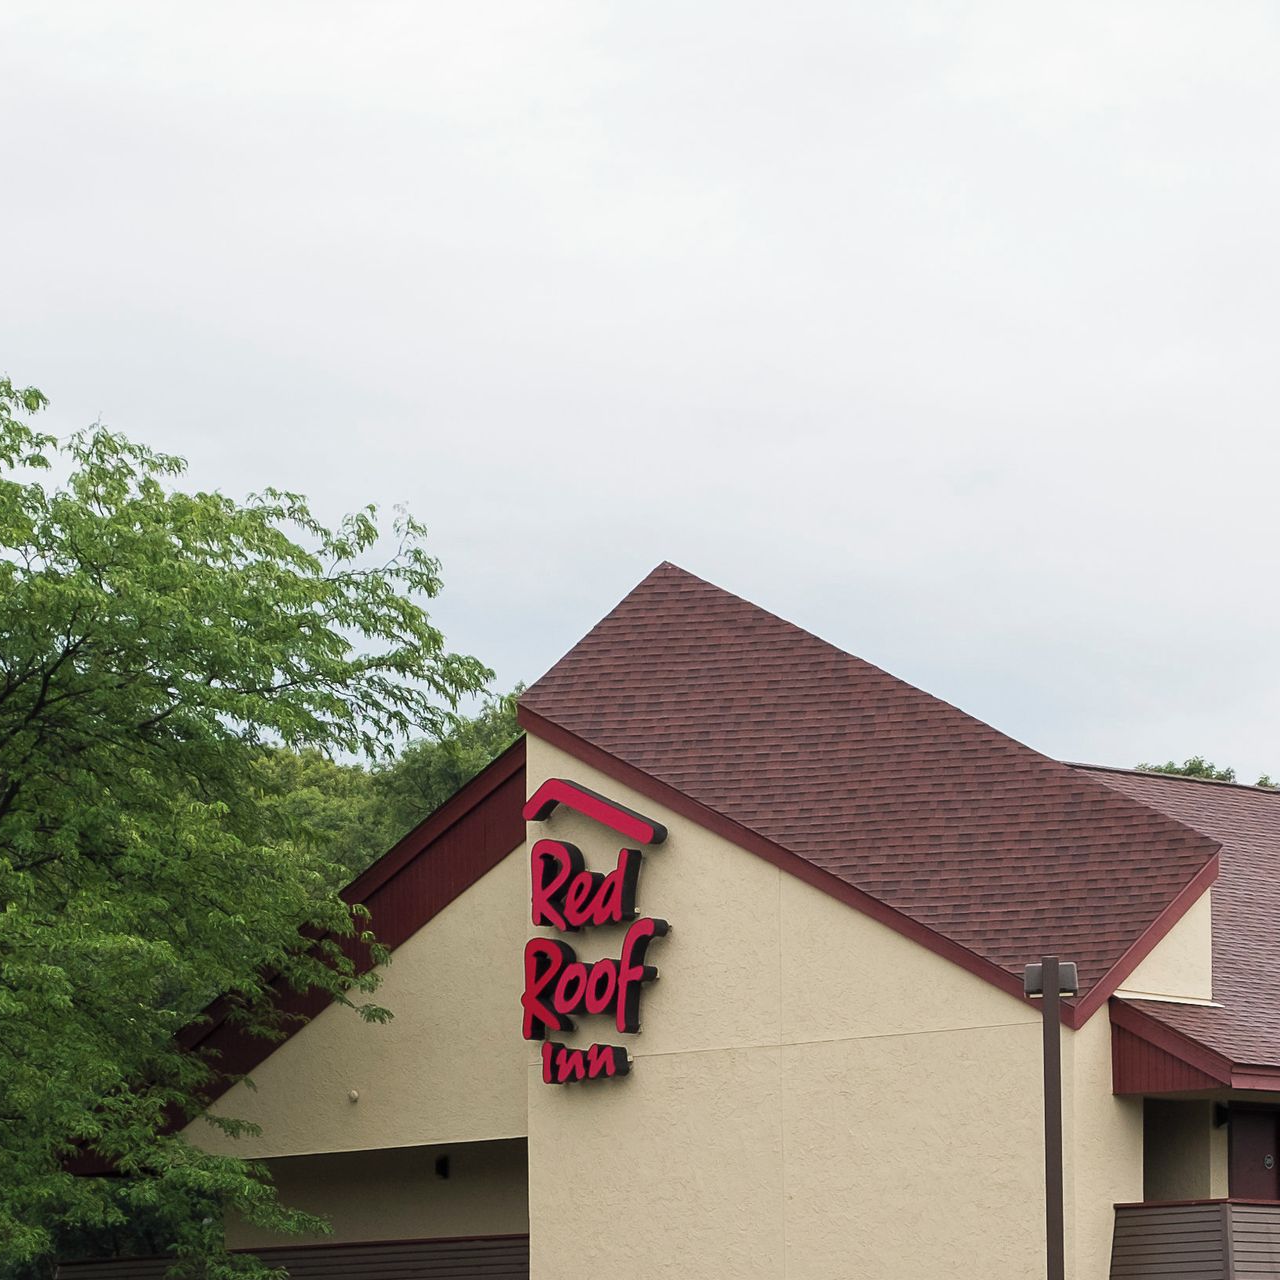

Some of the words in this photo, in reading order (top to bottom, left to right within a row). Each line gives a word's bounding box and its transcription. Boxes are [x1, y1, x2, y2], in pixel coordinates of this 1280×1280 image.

[531, 838, 635, 932] Red
[521, 917, 662, 1040] Roof
[541, 1041, 622, 1084] Inn
